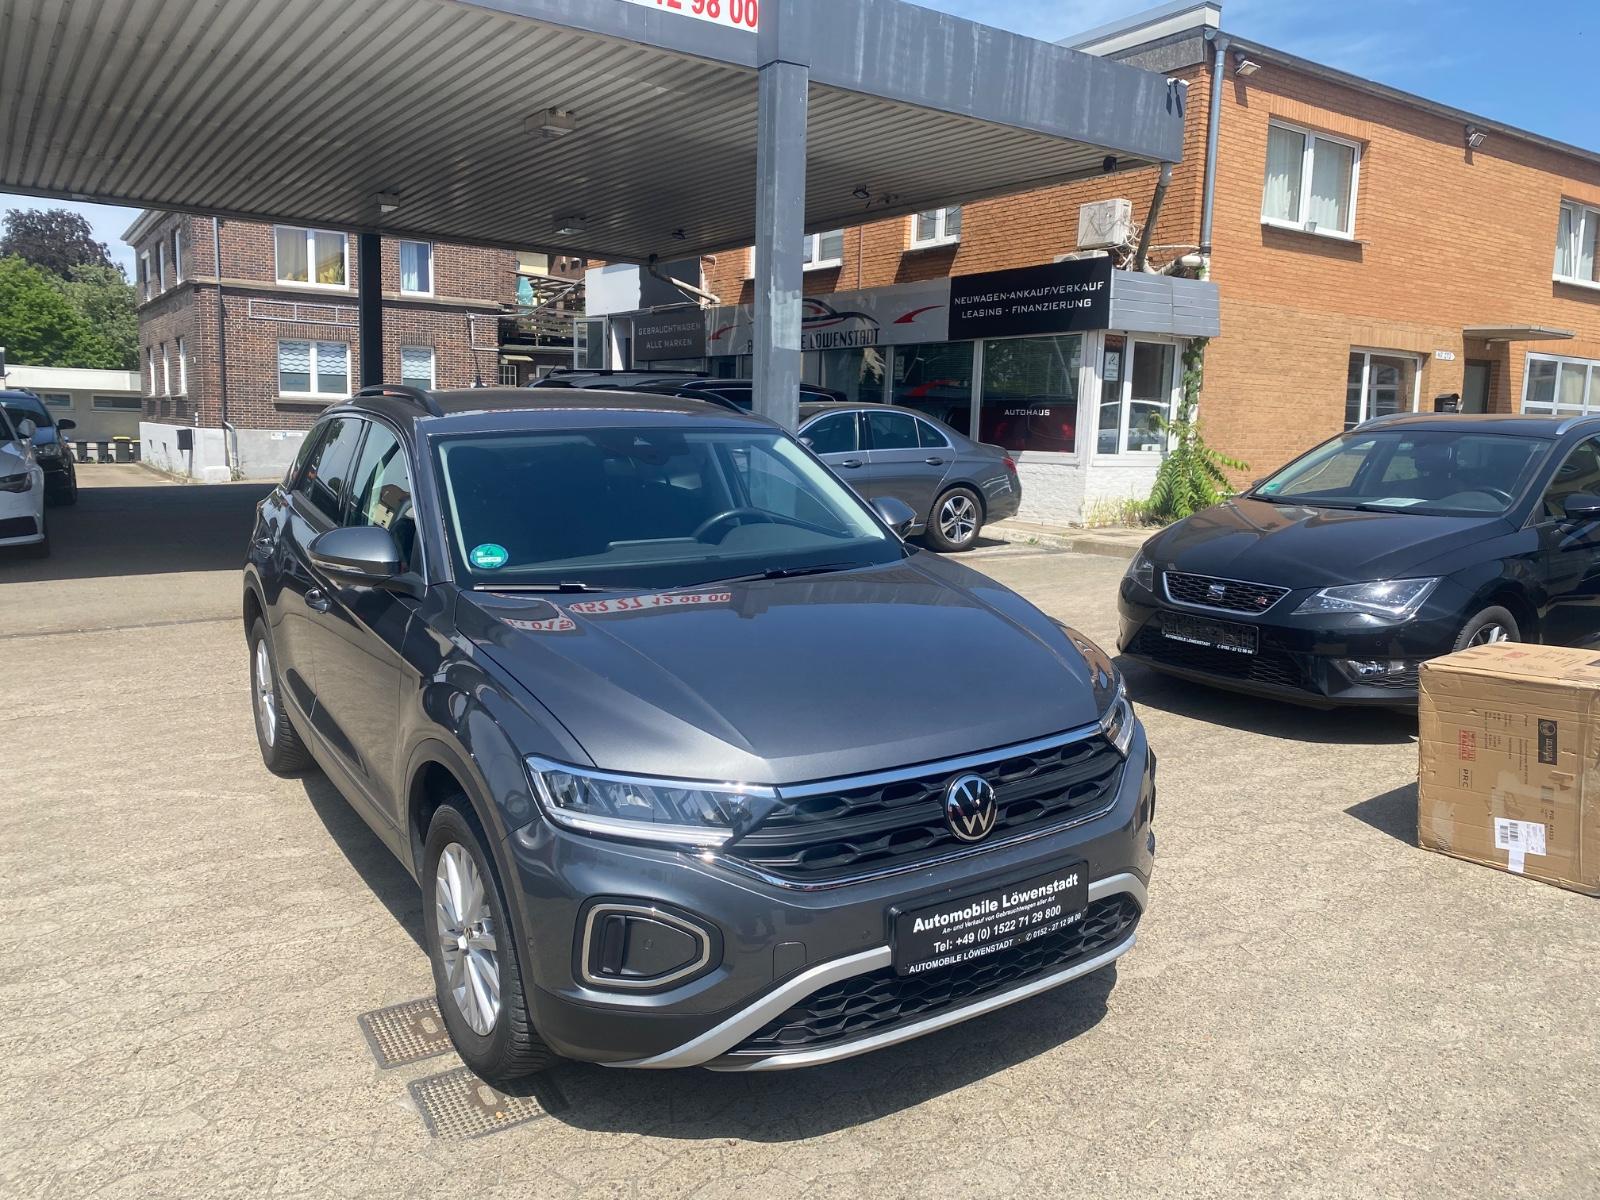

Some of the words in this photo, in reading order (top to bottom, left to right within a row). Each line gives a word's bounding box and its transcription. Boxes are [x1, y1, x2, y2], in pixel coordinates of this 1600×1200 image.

[729, 0, 758, 28] 00
[954, 281, 1105, 305] NEUWAGEN-ANKAUF/VERKAUF
[961, 307, 1002, 319] LEASING
[1012, 298, 1092, 315] FINANZIERUNG
[646, 340, 663, 350] ALLE
[664, 338, 692, 349] MARKEN
[809, 328, 881, 350] LÖWENSTADT
[1004, 409, 1050, 417] AUTOHAUS
[913, 899, 998, 933] Automobile
[1002, 873, 1078, 908] Löwenstadt
[934, 939, 953, 953] Tel:
[956, 932, 975, 946] +49
[977, 926, 990, 942] (0)
[994, 919, 1016, 935] 1522
[1019, 915, 1029, 928] 71
[1031, 911, 1043, 924] 29
[1045, 904, 1061, 919] 800
[953, 922, 964, 931] und
[996, 902, 1036, 918] Gebrauchtwagen
[908, 953, 962, 974] AUTOMOBILE
[963, 938, 1014, 960] LÖWENSTADT
[1033, 926, 1048, 938] 0152
[1060, 919, 1067, 928] 12
